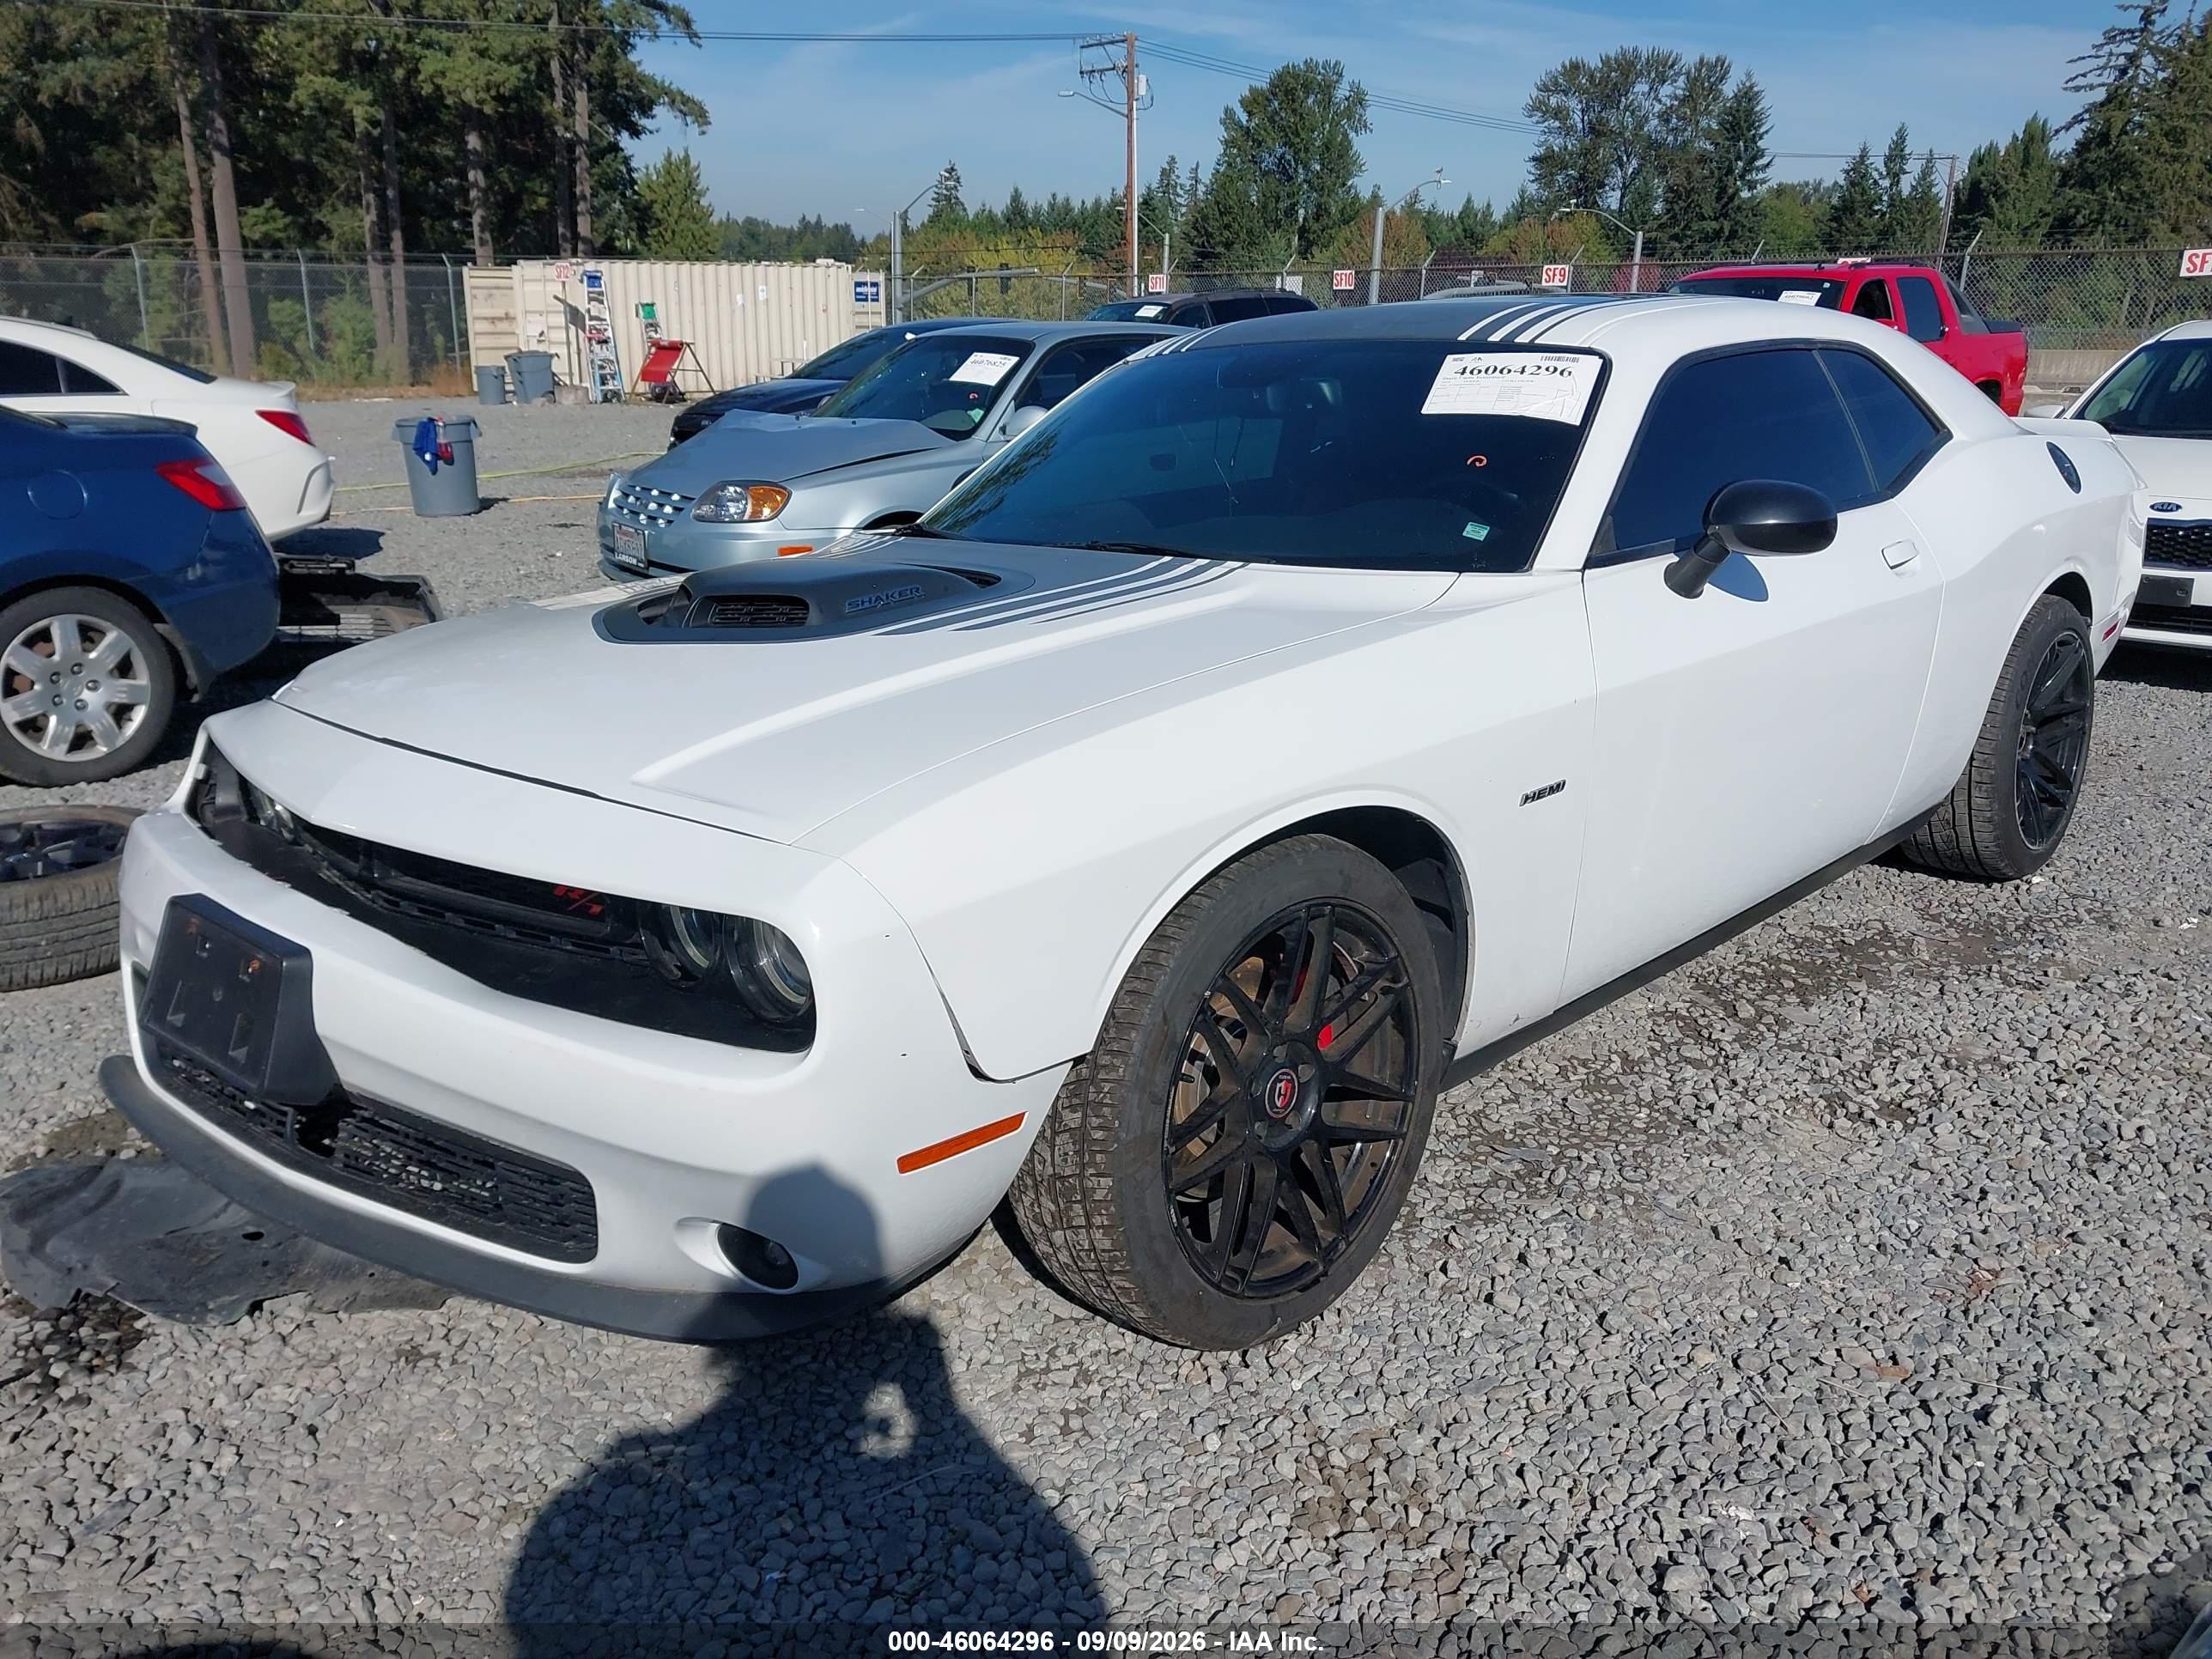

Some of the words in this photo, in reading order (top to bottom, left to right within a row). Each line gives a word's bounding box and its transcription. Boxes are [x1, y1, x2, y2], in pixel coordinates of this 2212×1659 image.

[2186, 252, 2212, 274] SF
[1151, 276, 1164, 289] SF11
[1334, 272, 1353, 288] SF10
[1544, 267, 1566, 283] SF9
[1454, 364, 1574, 379] 46064296
[2154, 502, 2177, 511] KIA
[846, 585, 924, 611] SHAKER
[1518, 778, 1566, 807] HEMI
